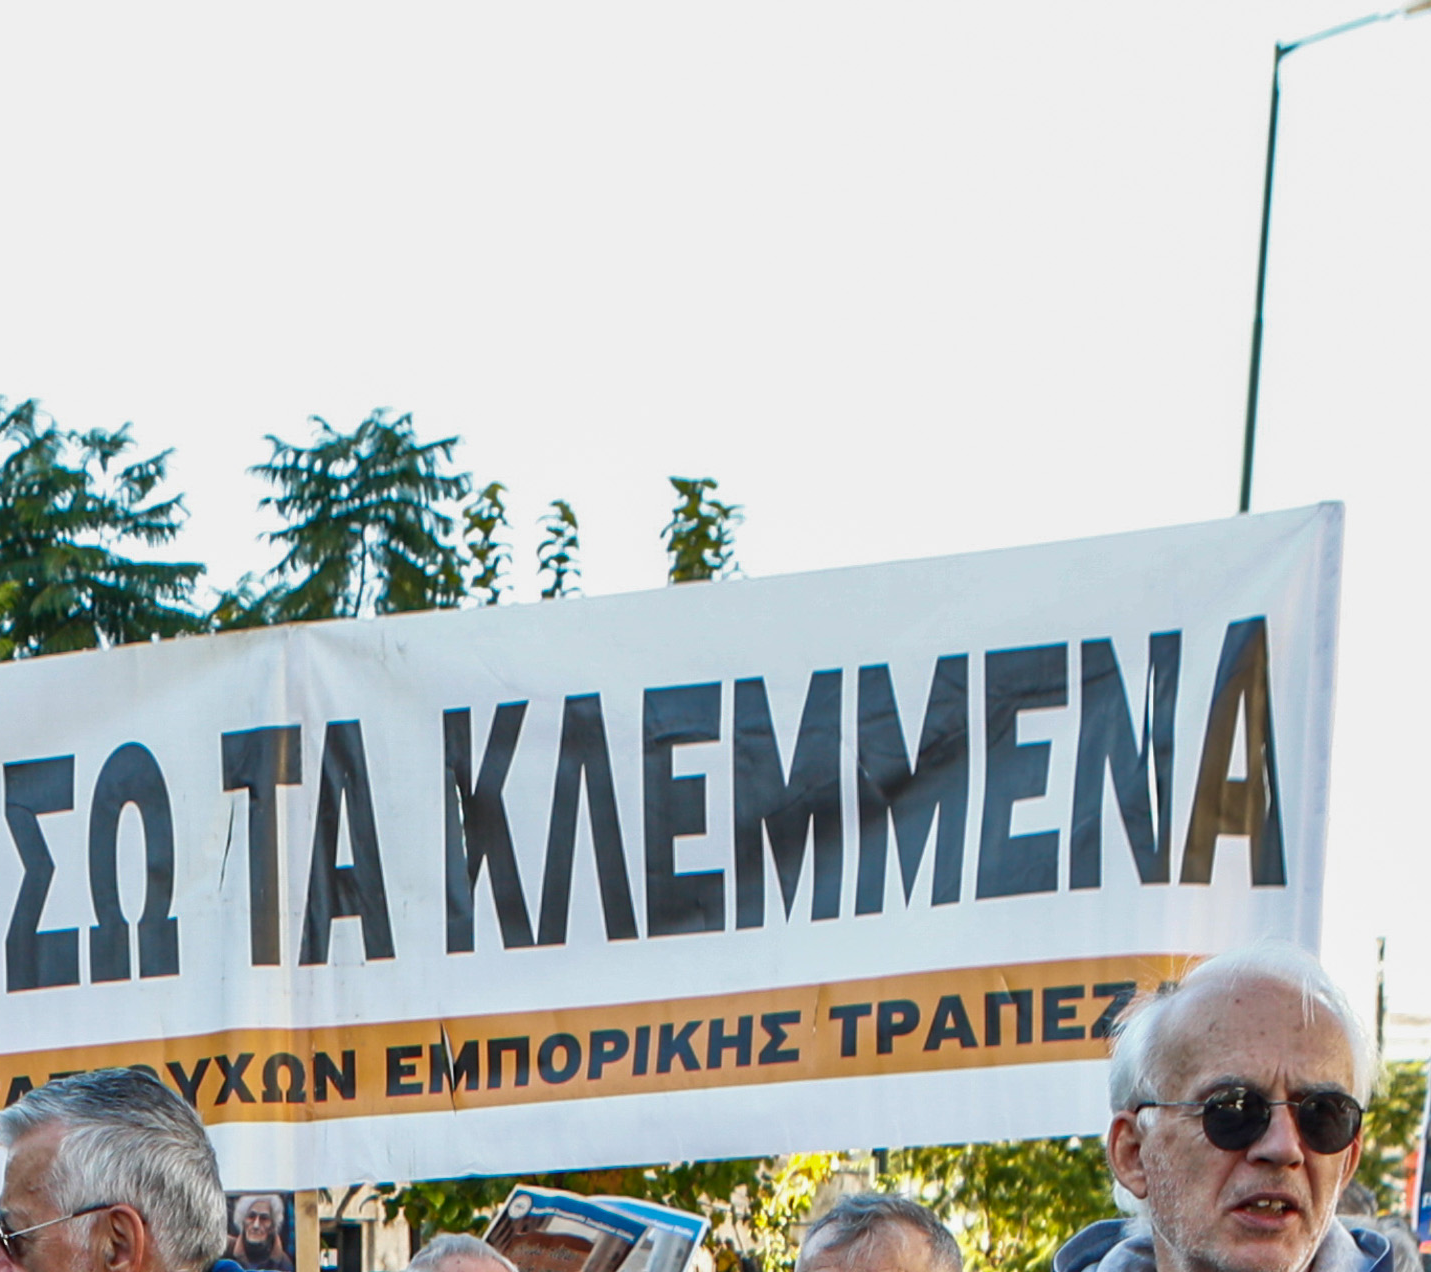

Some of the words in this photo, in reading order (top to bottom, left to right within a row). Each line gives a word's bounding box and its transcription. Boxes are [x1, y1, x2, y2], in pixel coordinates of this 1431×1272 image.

[220, 721, 397, 968] ΤΑ
[442, 613, 1288, 955] ΚΛΕΜΜΕΝΑ
[385, 1008, 802, 1099] ΕΜΠΟΡΙΚΗΣ
[828, 979, 1179, 1058] ΤΡΑΠΕΖ
